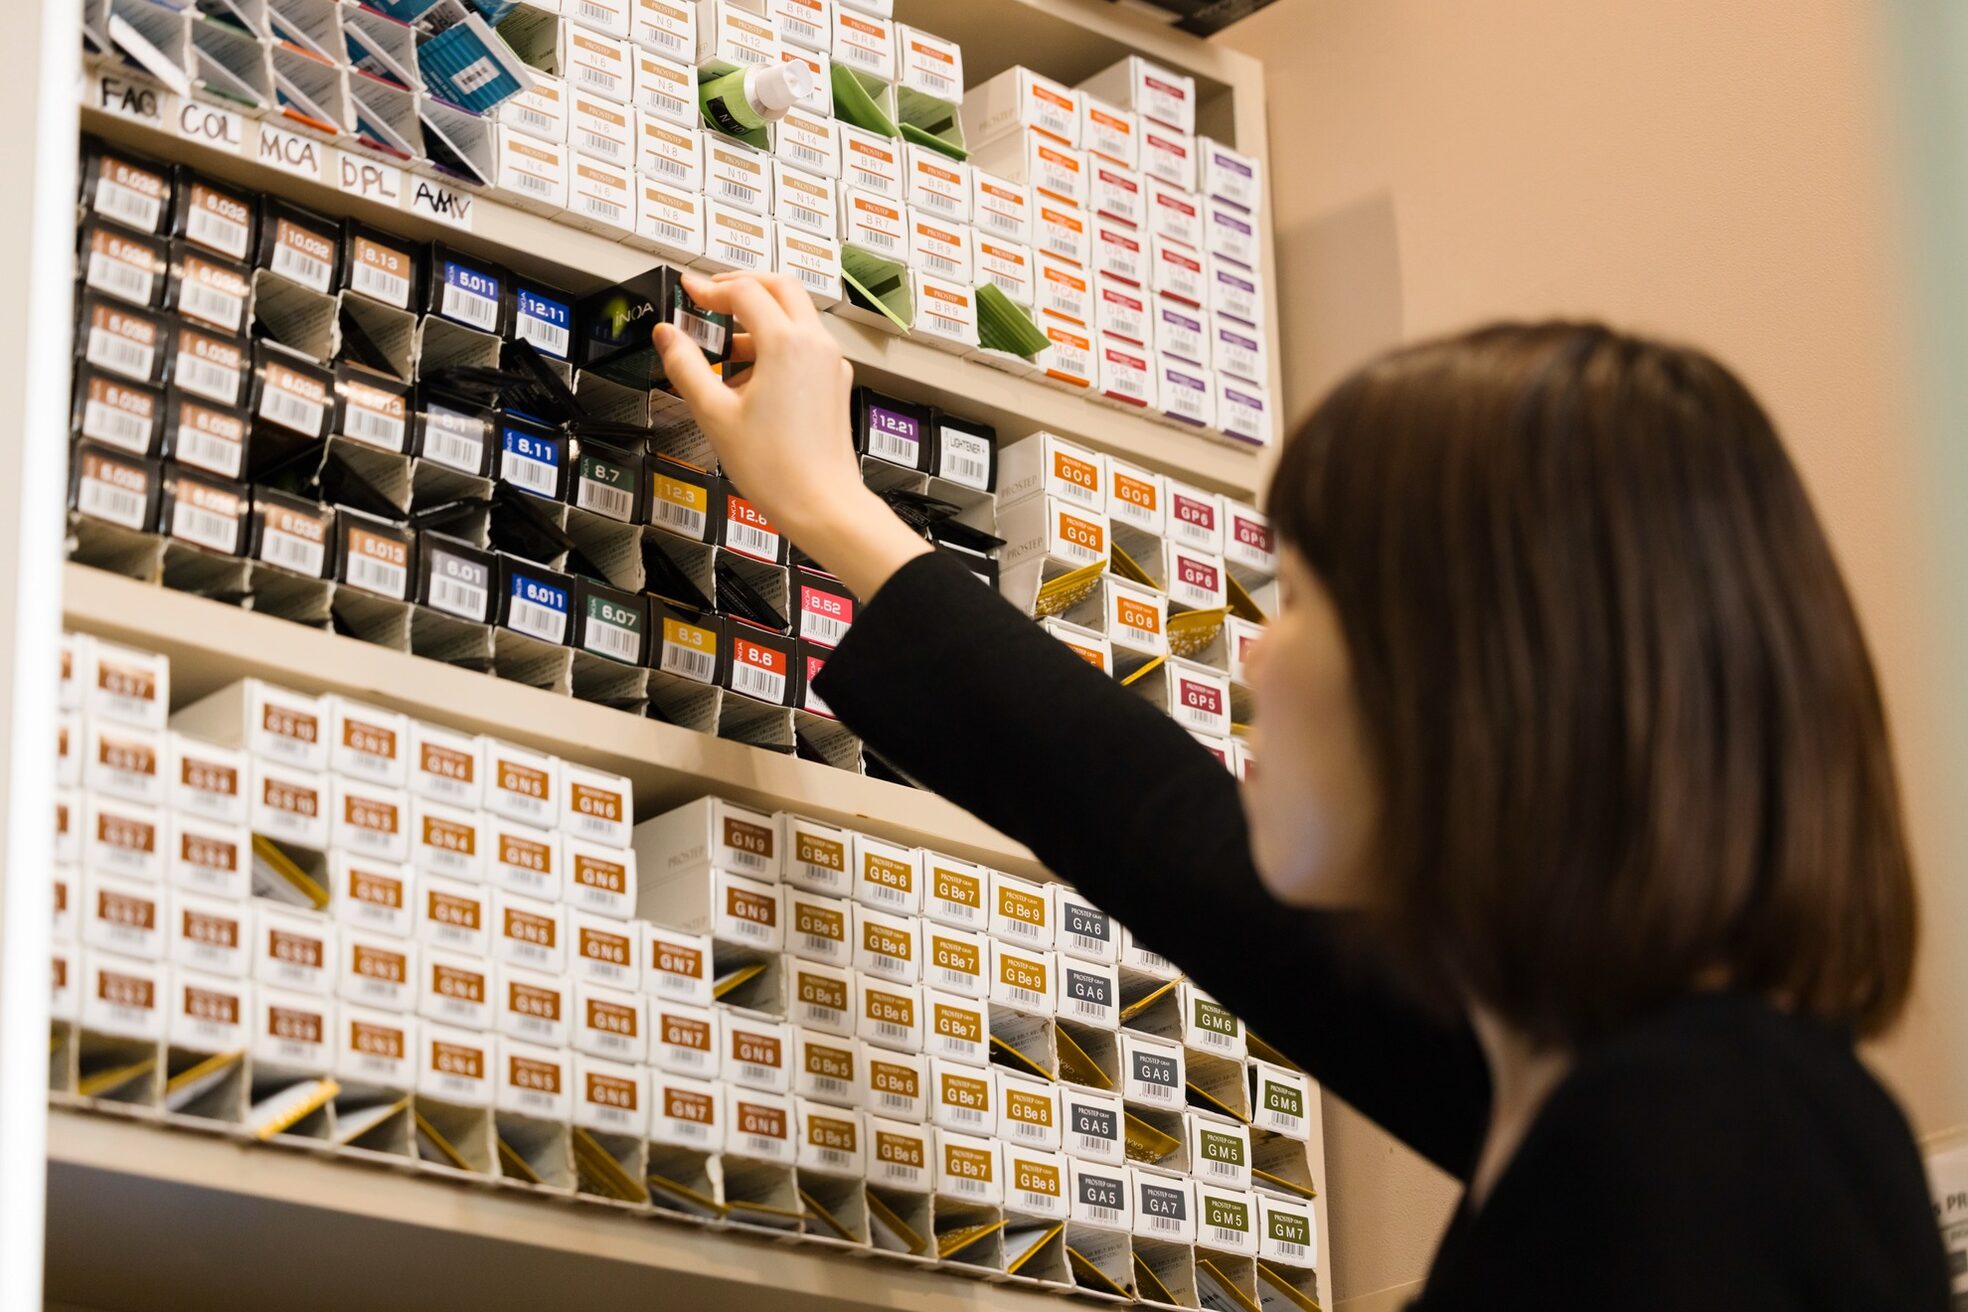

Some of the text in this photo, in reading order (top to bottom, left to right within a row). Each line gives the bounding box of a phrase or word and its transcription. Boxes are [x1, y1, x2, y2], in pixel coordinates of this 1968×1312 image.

[181, 104, 241, 145] COL
[260, 129, 319, 173] MCA
[343, 157, 397, 198] DPL
[460, 272, 494, 295] 5.011
[528, 298, 564, 322] 12.11
[880, 415, 913, 436] 12.21
[518, 438, 551, 460] 8.11
[595, 465, 620, 482] 8.7
[665, 483, 694, 503] 12.3
[739, 506, 767, 525] 12.6
[527, 584, 563, 608] 6.011
[811, 596, 841, 616] 8.52
[602, 604, 637, 627] 6.07
[678, 627, 703, 646] 8.3
[749, 648, 773, 666] 8.6
